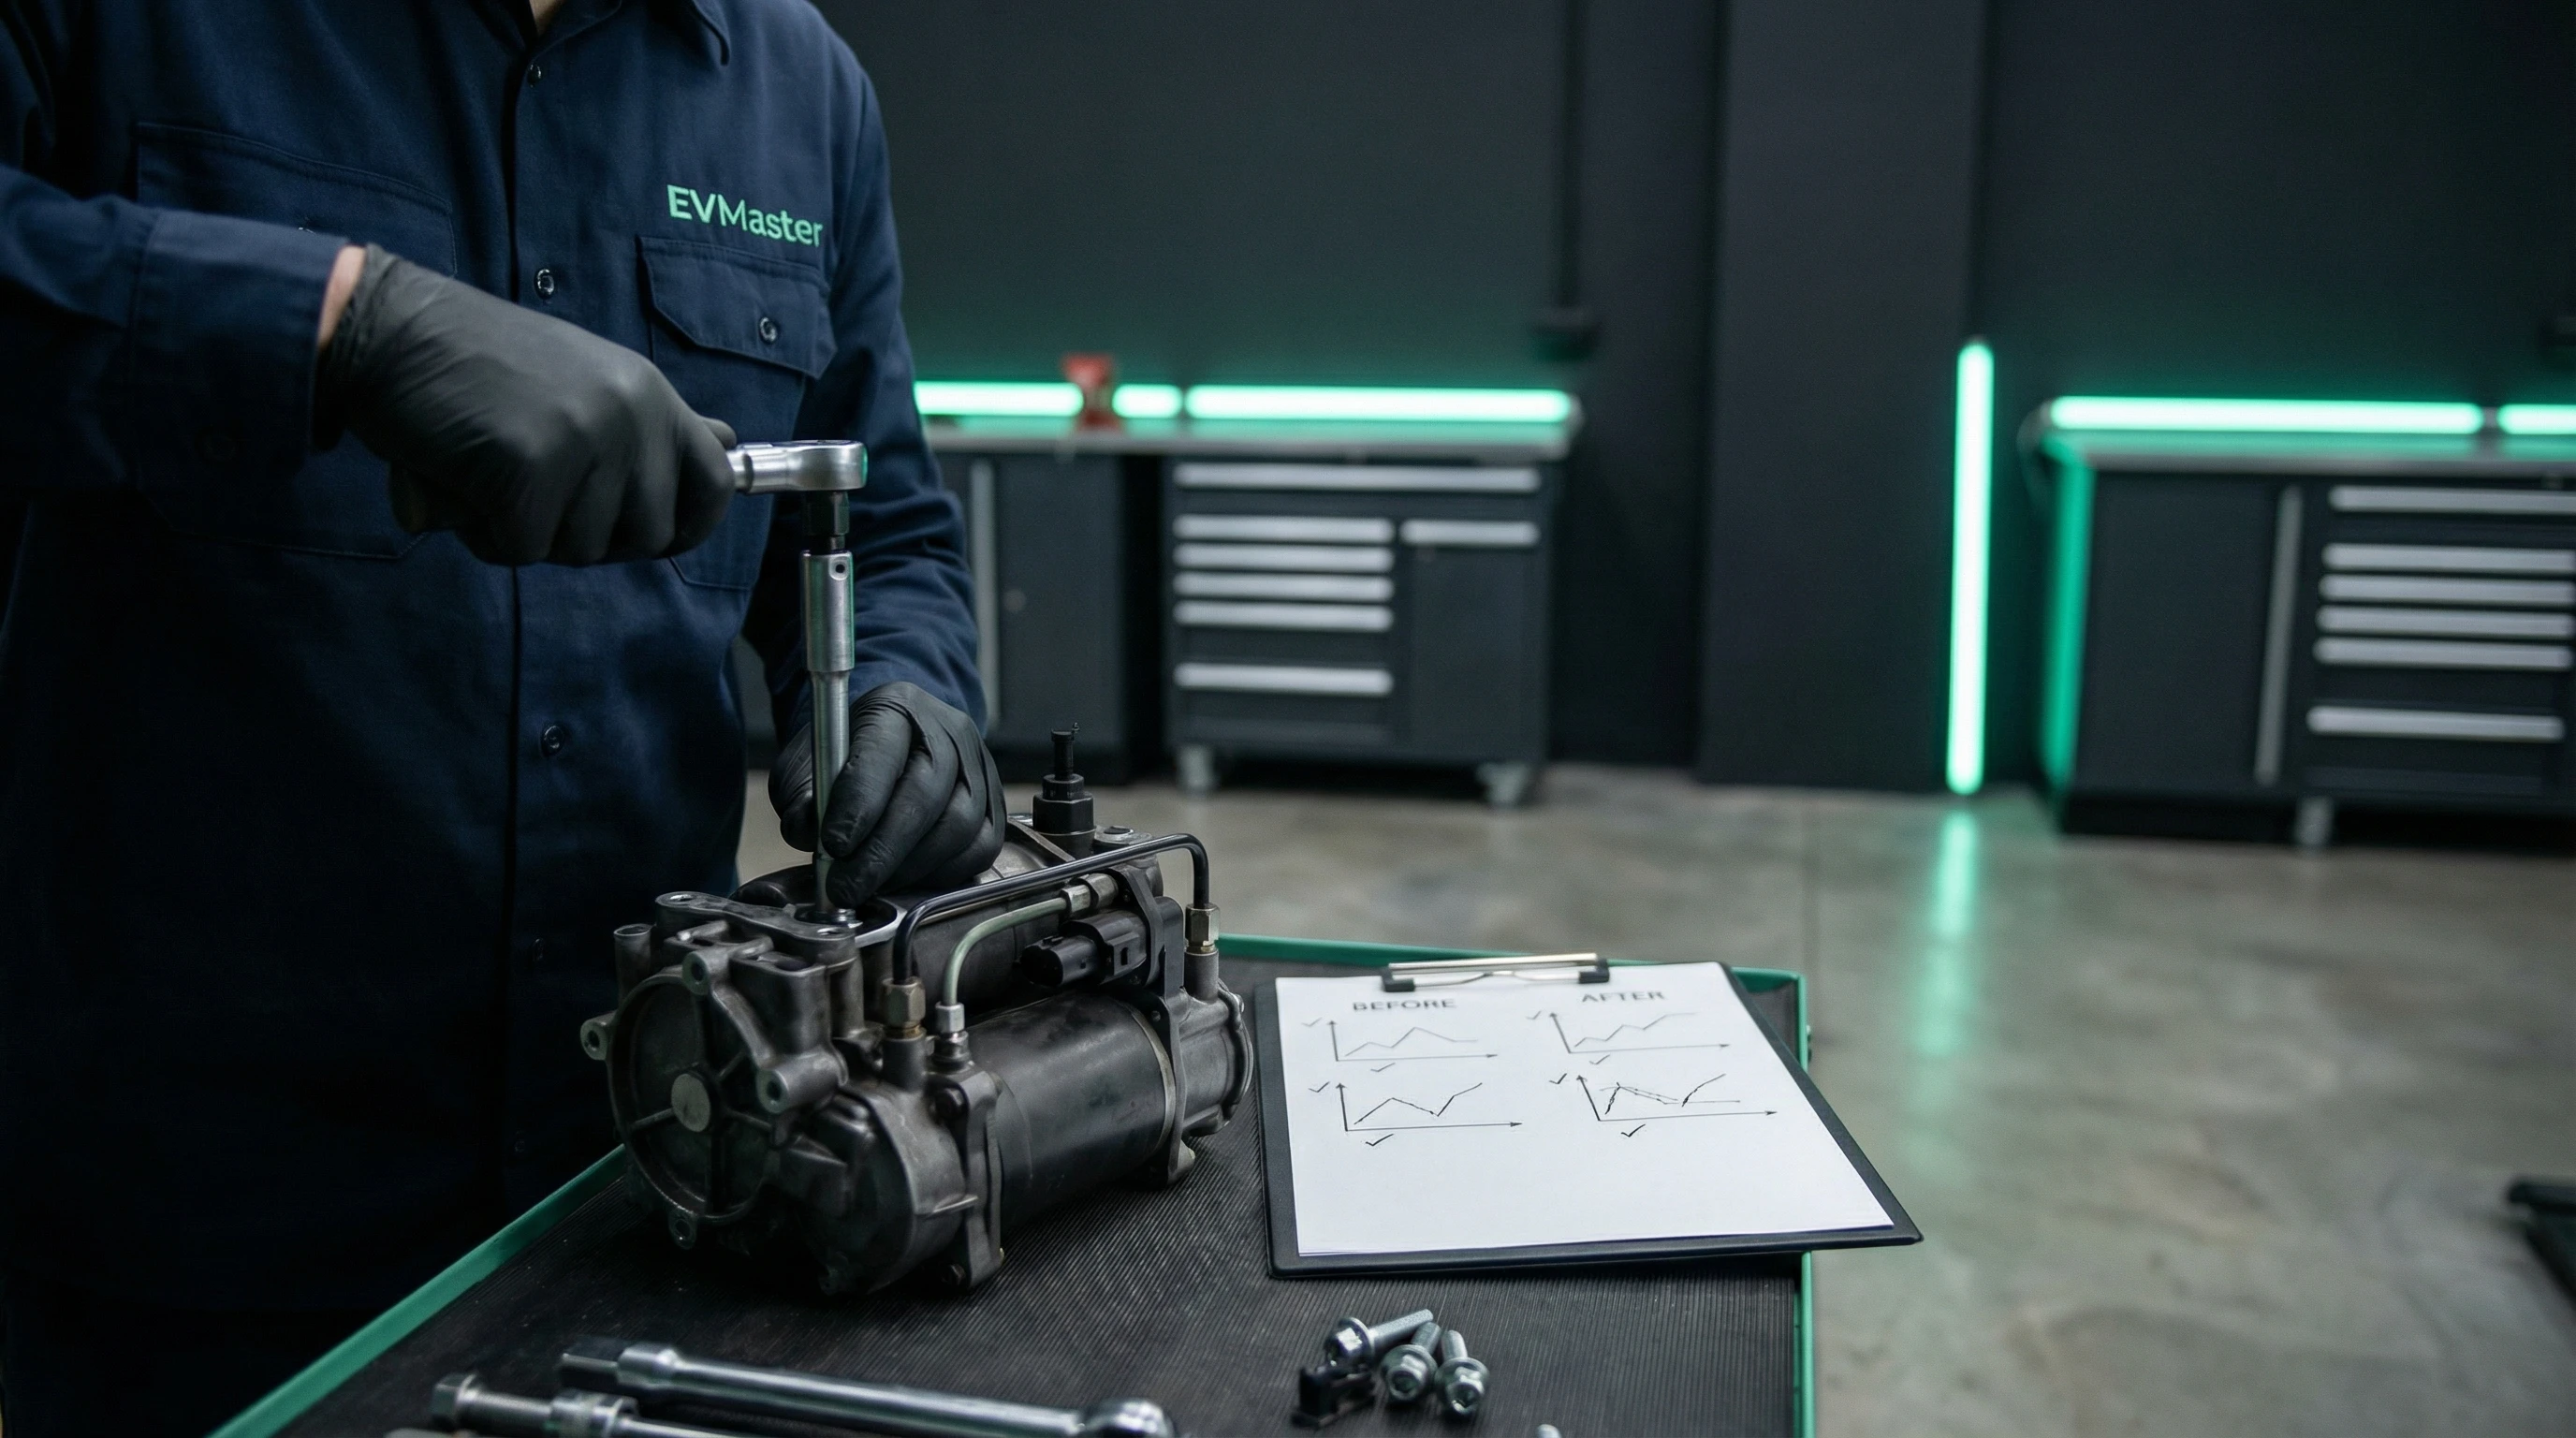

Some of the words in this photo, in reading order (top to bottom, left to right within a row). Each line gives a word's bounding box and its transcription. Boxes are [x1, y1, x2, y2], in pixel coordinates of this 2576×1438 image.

[666, 184, 823, 247] EVMaster
[1581, 990, 1666, 1003] AFTER
[1353, 999, 1457, 1011] BEFORE
